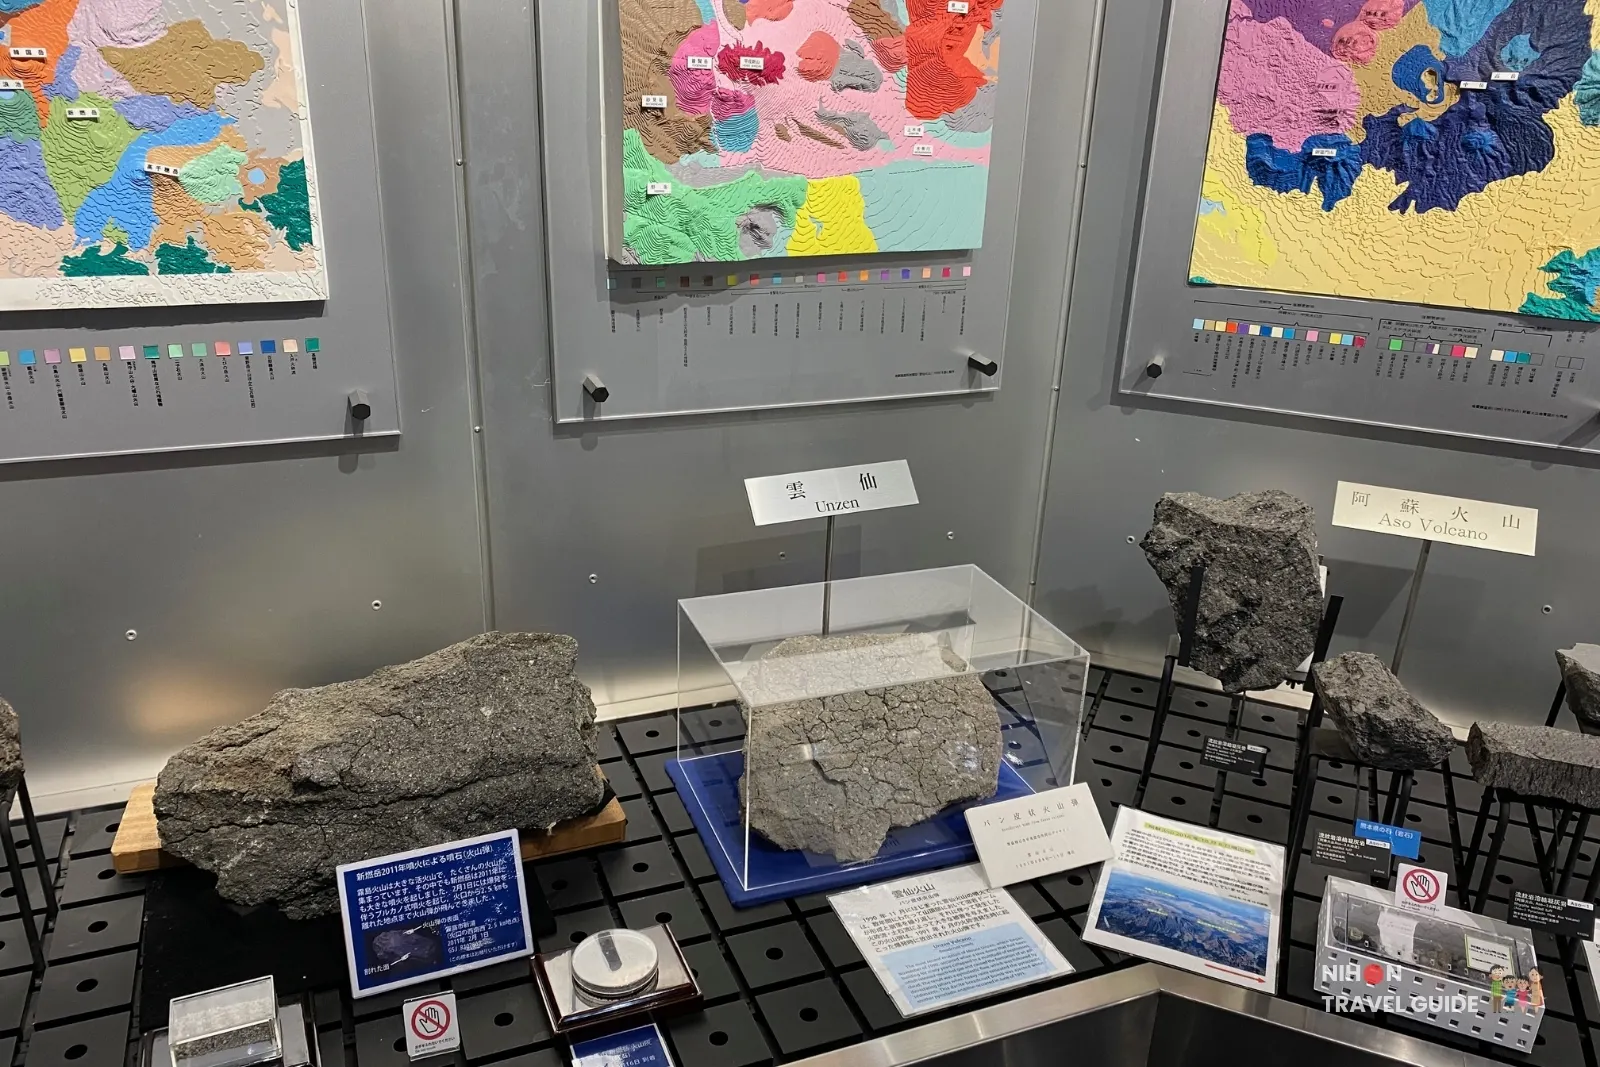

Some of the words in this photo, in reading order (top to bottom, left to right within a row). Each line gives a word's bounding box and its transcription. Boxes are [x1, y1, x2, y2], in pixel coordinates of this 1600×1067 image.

[786, 473, 878, 500] 雲仙
[816, 499, 860, 513] Unzen
[1352, 491, 1520, 530] 阿蘇火山
[1378, 512, 1412, 529] Aso
[1420, 518, 1488, 541] Volcano
[984, 798, 1078, 826] パン皮状火山弾
[890, 882, 936, 899] 雲仙火山
